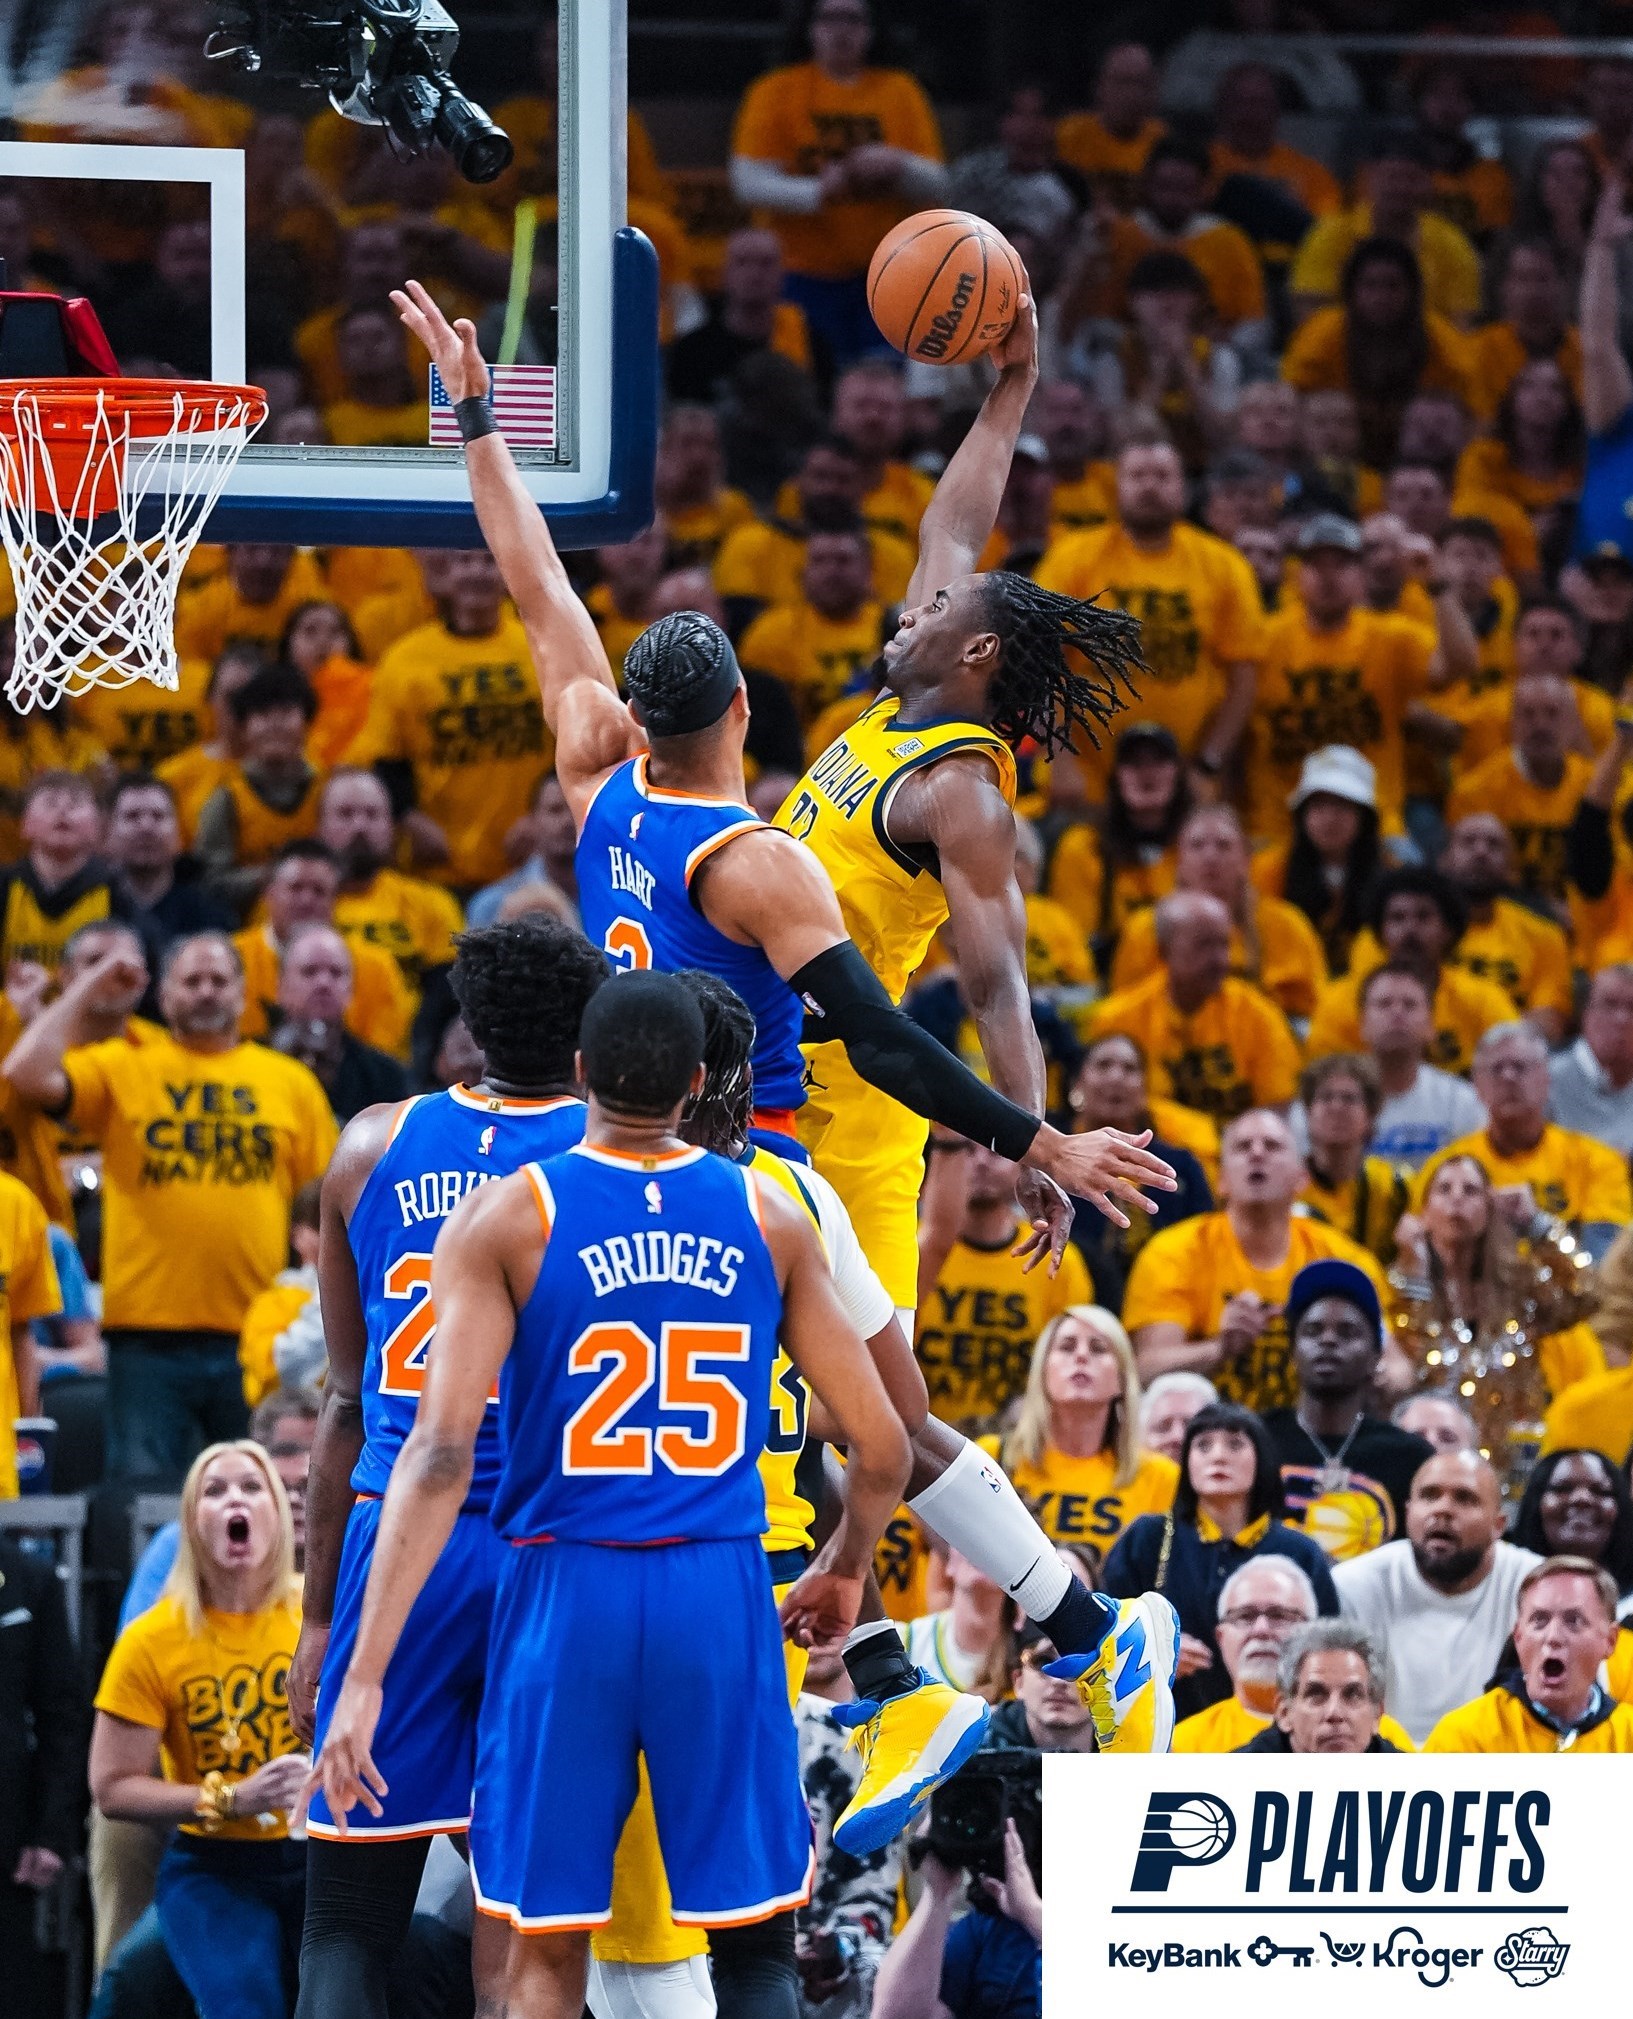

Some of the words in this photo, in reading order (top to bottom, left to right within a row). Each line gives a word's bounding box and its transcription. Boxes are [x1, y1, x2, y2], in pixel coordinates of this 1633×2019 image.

[915, 272, 977, 358] Wilson
[440, 664, 526, 699] YES
[608, 846, 656, 911] HART
[163, 1081, 256, 1115] YES
[145, 1119, 275, 1161] CERS
[578, 1230, 745, 1298] BRIDGES
[938, 1286, 1029, 1331] YES
[562, 1320, 752, 1477] 25
